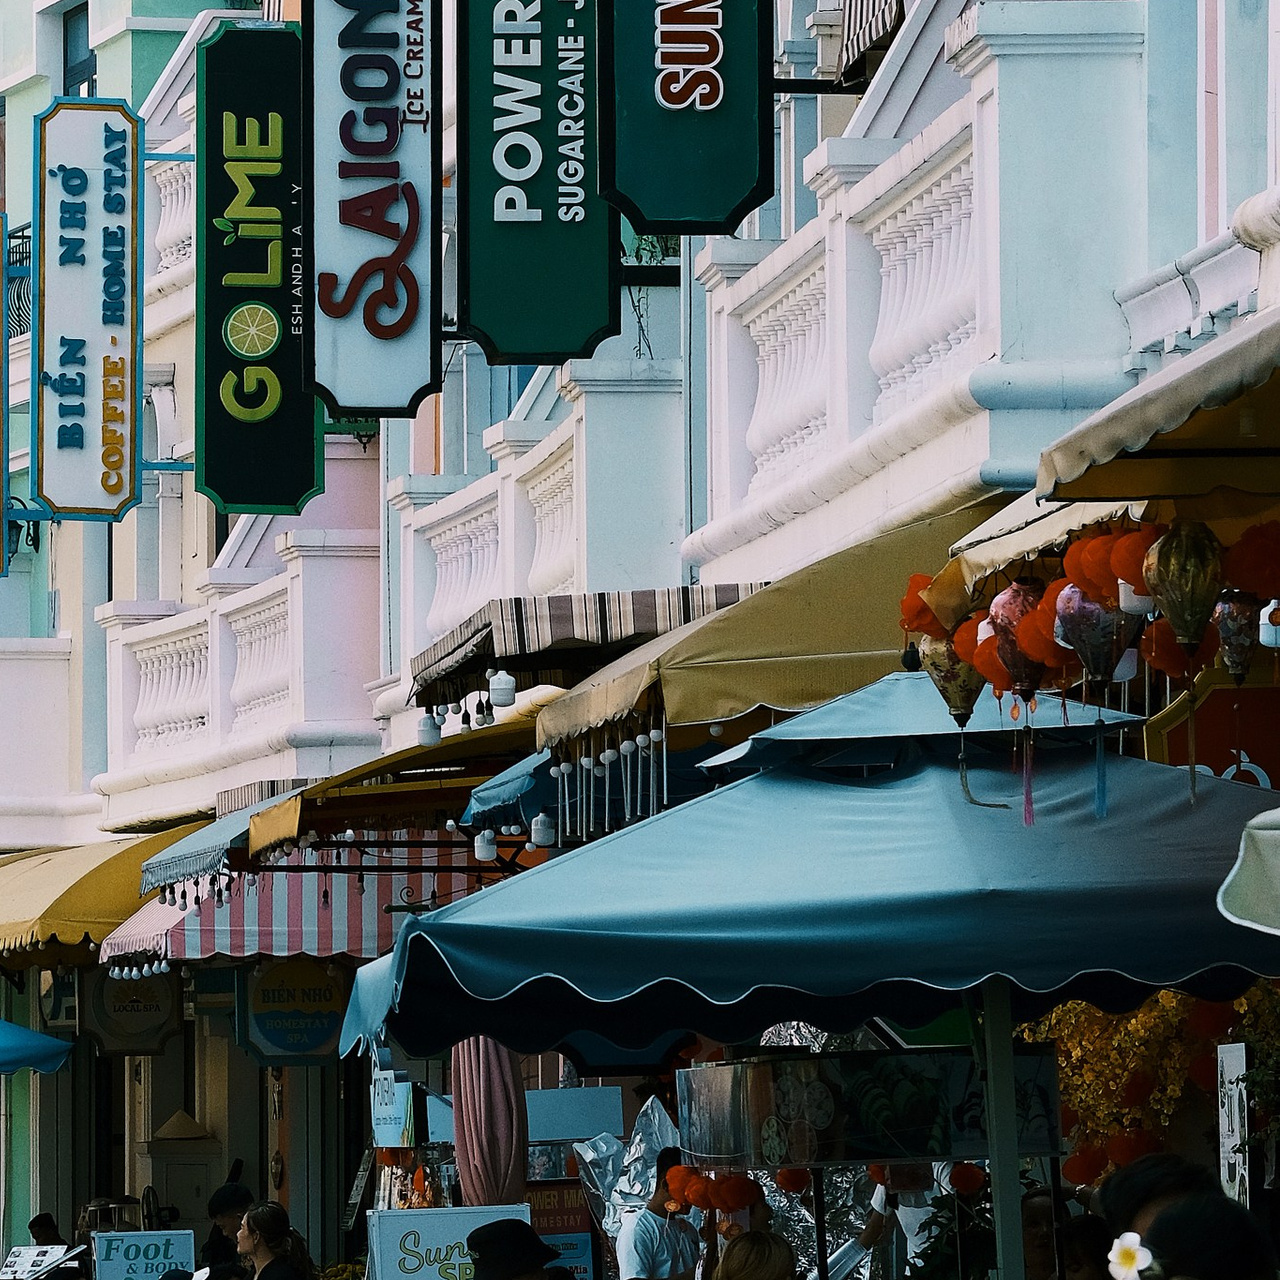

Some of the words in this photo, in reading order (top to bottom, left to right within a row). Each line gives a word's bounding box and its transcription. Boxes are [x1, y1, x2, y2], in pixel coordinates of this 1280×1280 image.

[556, 35, 586, 222] SUGARCANE
[102, 122, 128, 216] STAY
[101, 225, 127, 326] HOME
[291, 263, 302, 297] AND
[100, 356, 126, 496] COFFEE
[113, 1004, 142, 1013] LOCAL
[143, 1004, 161, 1013] SPA
[287, 1033, 310, 1044] SPA
[522, 1190, 559, 1210] OWER
[532, 1214, 582, 1229] OMESTAY
[101, 1238, 175, 1262] Foot
[398, 1230, 471, 1274] Sun
[126, 1263, 139, 1275] &
